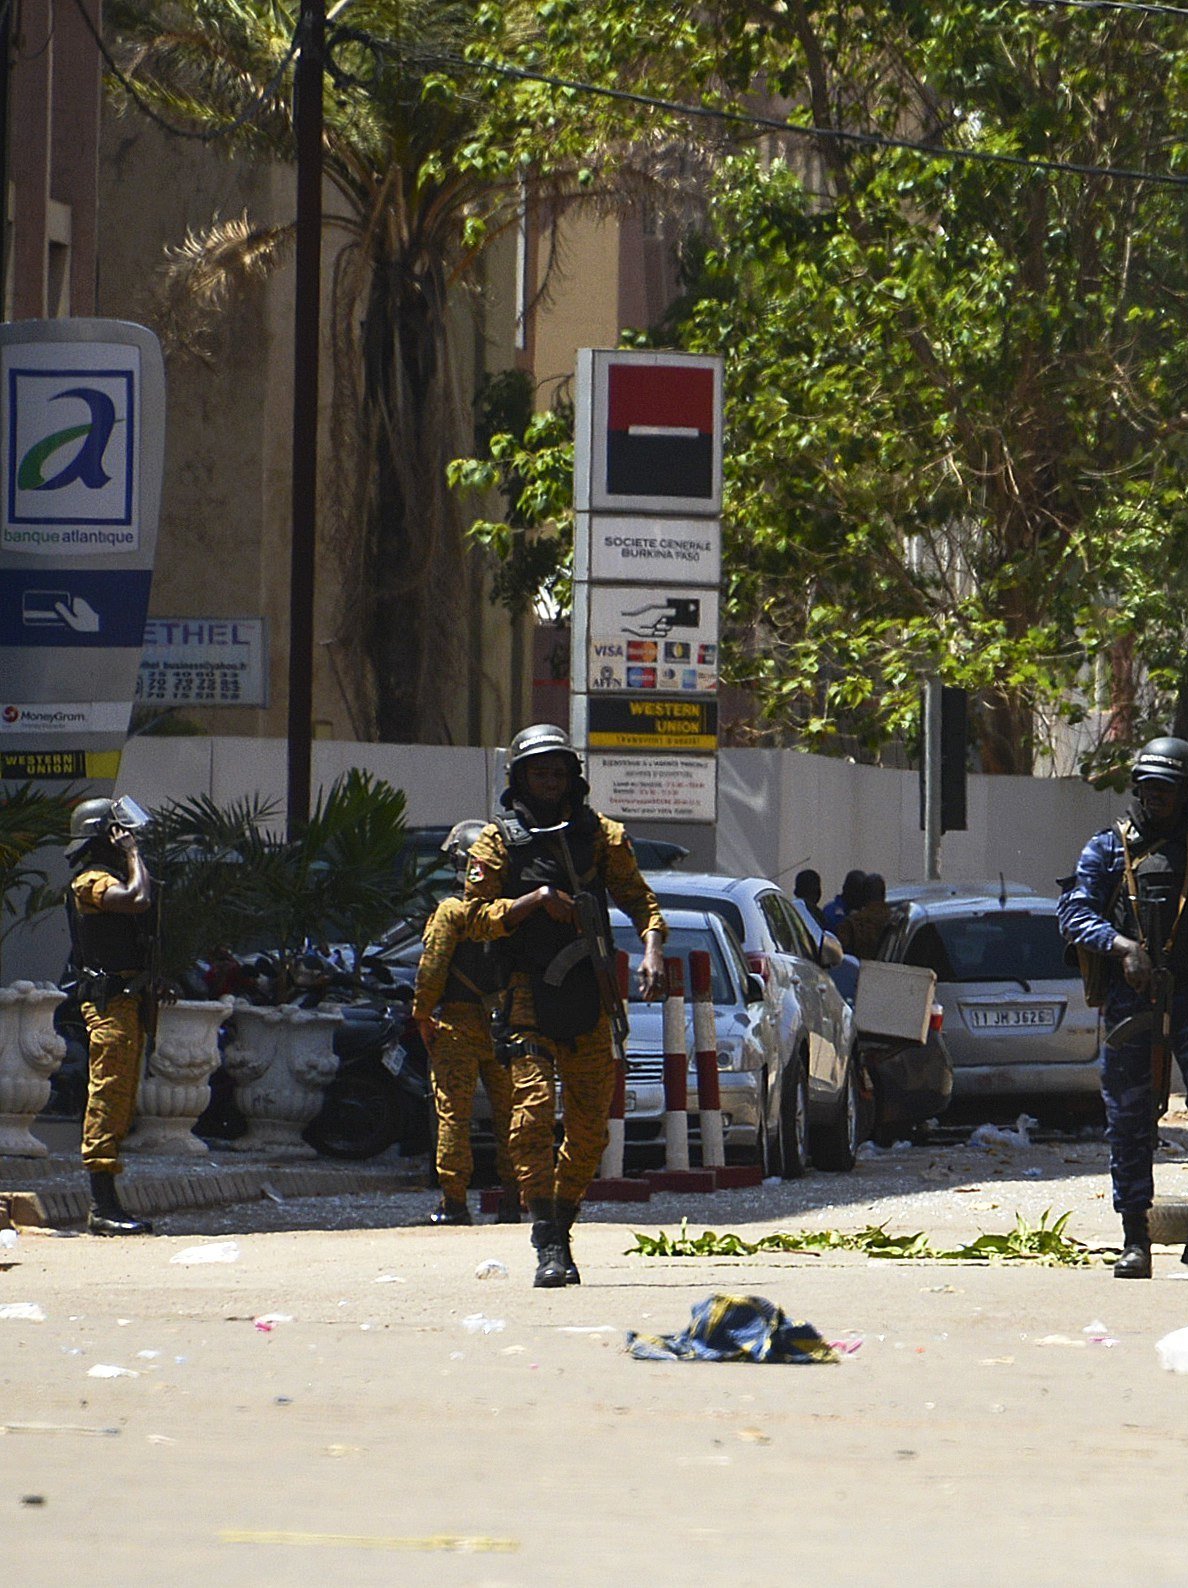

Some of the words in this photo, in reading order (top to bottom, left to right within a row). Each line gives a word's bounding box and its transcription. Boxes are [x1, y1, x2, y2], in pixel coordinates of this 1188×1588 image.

[4, 529, 60, 545] banque
[62, 530, 134, 547] atlantique
[604, 536, 658, 549] SOCIETE
[660, 539, 712, 552] GENERALE
[621, 548, 674, 559] BURKINA
[676, 551, 700, 562] FASO
[594, 644, 624, 658] VISA
[630, 701, 701, 717] WESTERN
[21, 710, 85, 723] MoneyGram
[656, 719, 700, 734] UNION
[4, 754, 73, 766] WESTERN
[27, 764, 72, 775] UNION
